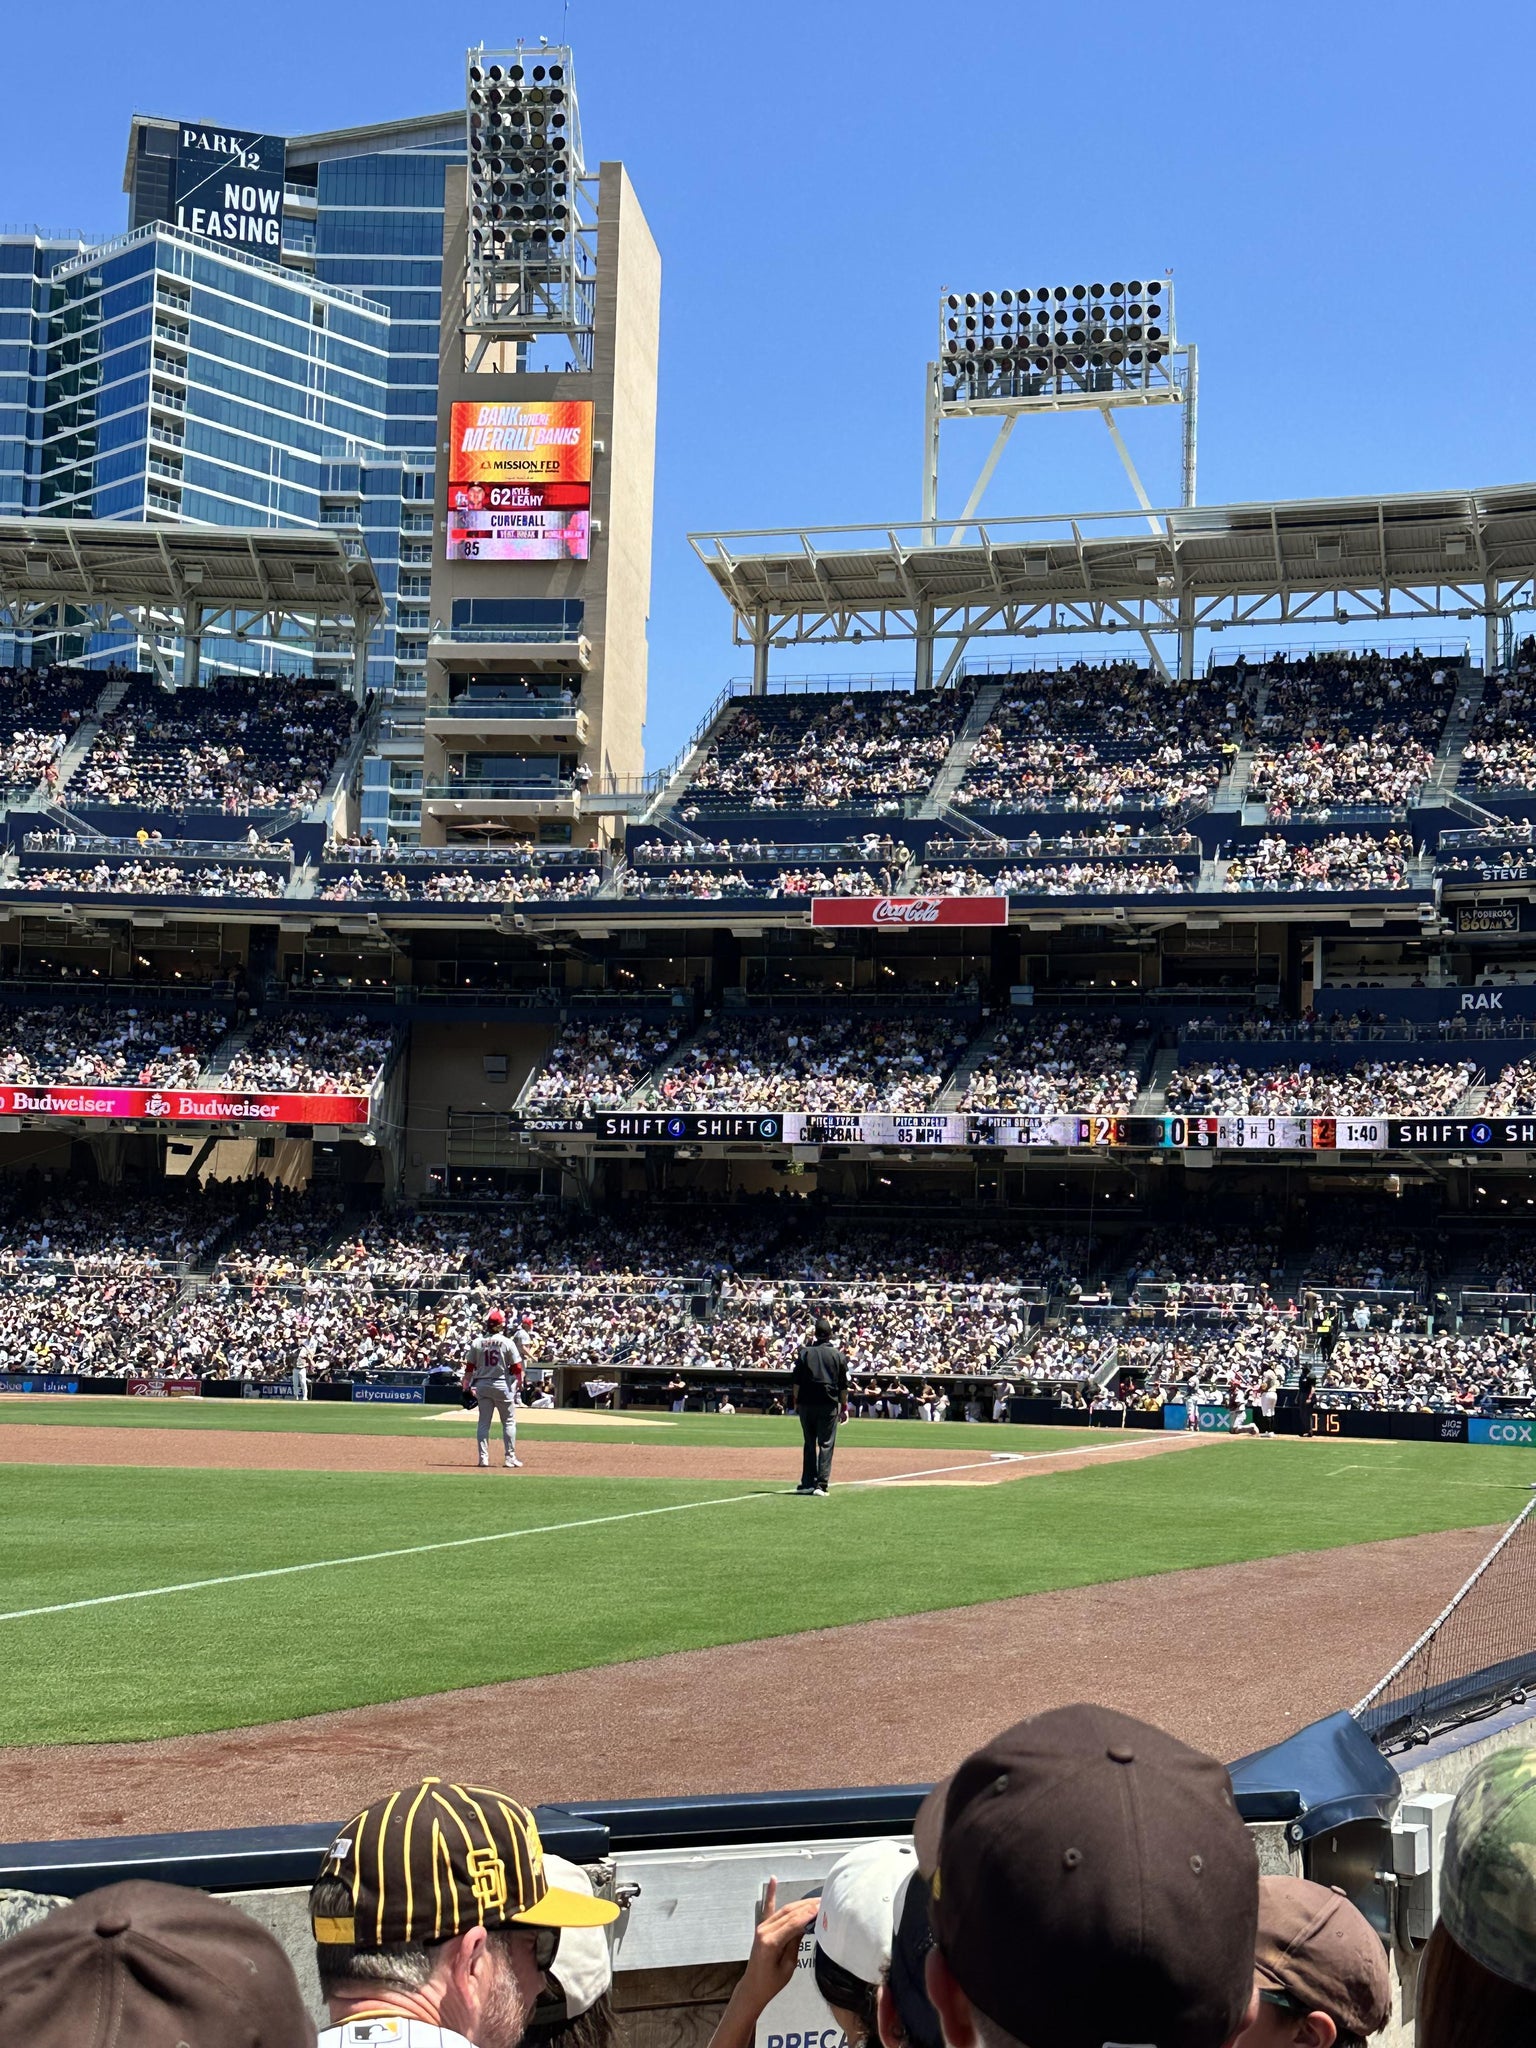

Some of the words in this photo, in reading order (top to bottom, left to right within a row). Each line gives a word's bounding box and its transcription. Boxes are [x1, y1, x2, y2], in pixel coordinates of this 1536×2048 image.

[182, 129, 245, 155] PARK
[238, 152, 261, 171] 12
[224, 183, 280, 215] NOW
[177, 206, 280, 245] LEASING
[477, 406, 520, 426] BANK
[519, 413, 550, 425] WHERE
[461, 427, 536, 452] MERRILL
[536, 427, 581, 445] BANKS
[493, 461, 537, 469] MISSION
[540, 460, 560, 469] FED
[490, 488, 511, 505] 62
[512, 487, 530, 495] KYLE
[512, 495, 543, 506] LEAHY
[490, 515, 546, 527] CURVEBALL
[464, 541, 479, 556] 85
[1482, 868, 1528, 881] STEVE
[872, 899, 943, 922] Coca-Cola
[1460, 910, 1471, 919] LA
[1473, 908, 1513, 919] PODEROSA
[1461, 992, 1503, 1010] RAK
[12, 1092, 116, 1113] Budweiser
[178, 1097, 280, 1117] Budweiser
[524, 1120, 567, 1130] SONY
[836, 1117, 855, 1126] TYPE
[988, 1117, 1012, 1127] PITCH
[800, 1127, 865, 1142] CUBALL
[898, 1128, 913, 1142] 85
[915, 1129, 942, 1142] MPH
[1095, 1117, 1110, 1145] 2
[1171, 1117, 1185, 1145] 0
[1347, 1125, 1377, 1141] 1:40
[485, 1349, 499, 1366] 16
[1200, 1412, 1230, 1428] OX
[1326, 1414, 1340, 1432] 15
[1441, 1428, 1461, 1437] SAW
[1489, 1424, 1533, 1442] COX
